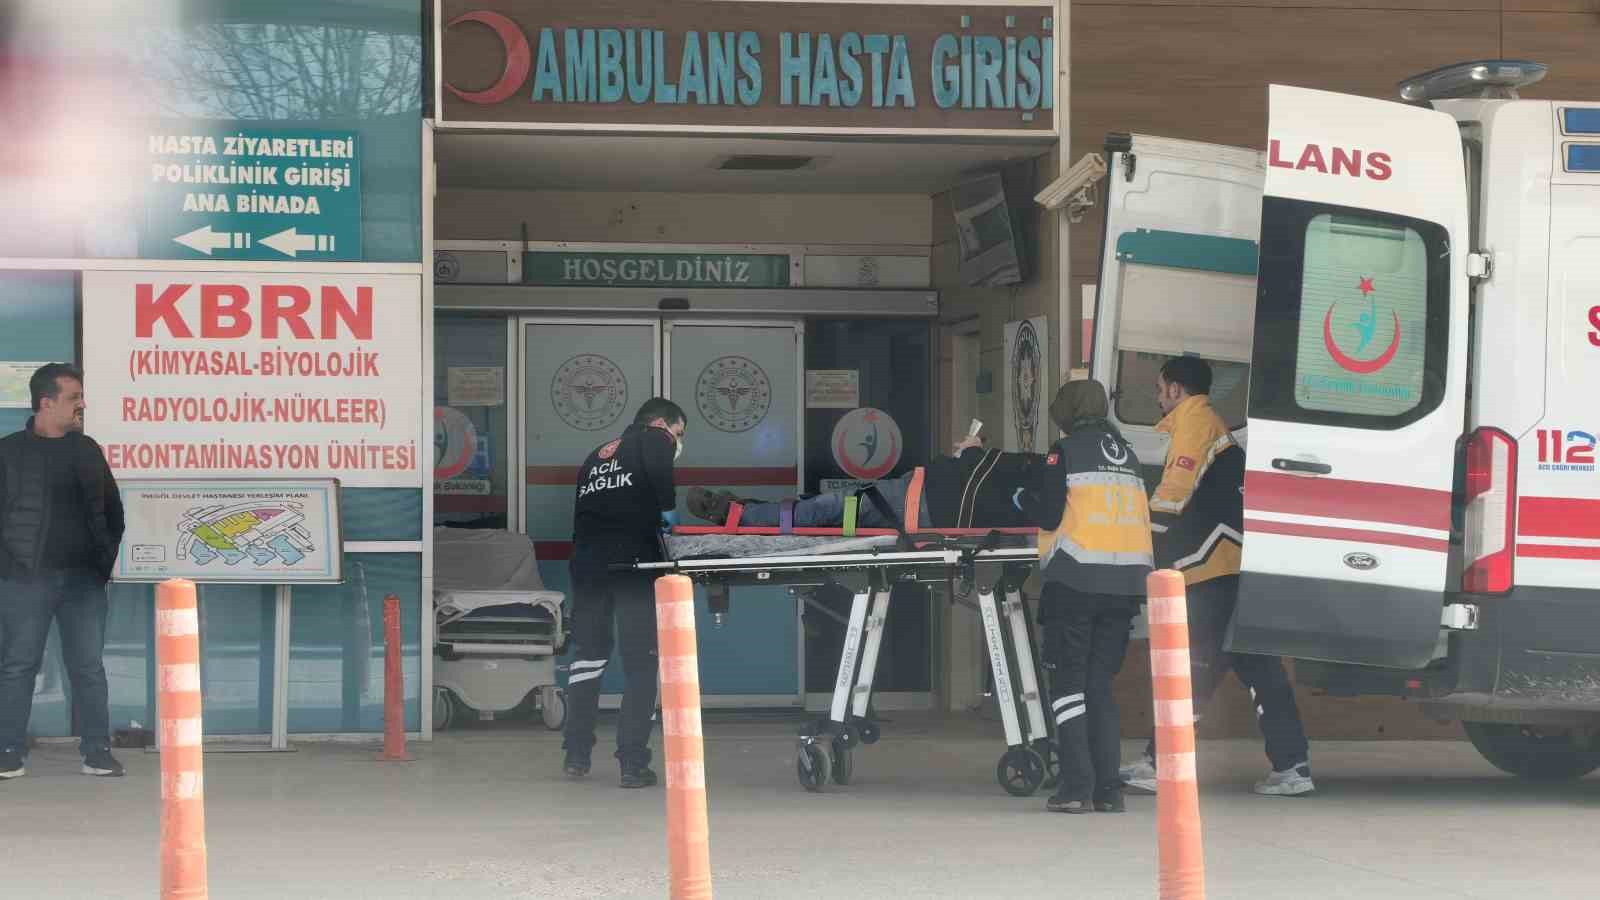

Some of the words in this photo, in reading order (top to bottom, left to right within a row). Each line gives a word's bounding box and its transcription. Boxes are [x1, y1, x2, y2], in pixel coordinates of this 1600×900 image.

[532, 27, 762, 107] AMBULANS
[780, 32, 916, 108] HASTA
[931, 15, 1053, 121] GİRİŞİ
[149, 135, 218, 156] HASTA
[223, 132, 354, 158] ZİYARETLERİ
[1269, 139, 1393, 181] LANS
[152, 160, 278, 185] POLİKLİNİK
[284, 162, 351, 191] GİRİŞİ
[183, 192, 230, 213] ANA
[236, 189, 321, 215] BİNADA
[563, 256, 750, 284] HOŞGELDİNİZ
[135, 283, 374, 340] KBRN
[129, 345, 380, 380] (KİMYASAL-BİYOLOJİK
[122, 392, 387, 429] RADYOLOJİK-NÜKLEER)
[327, 439, 417, 471] ÜNİTESİ
[1536, 429, 1597, 463] 112
[589, 459, 623, 479] ACİL
